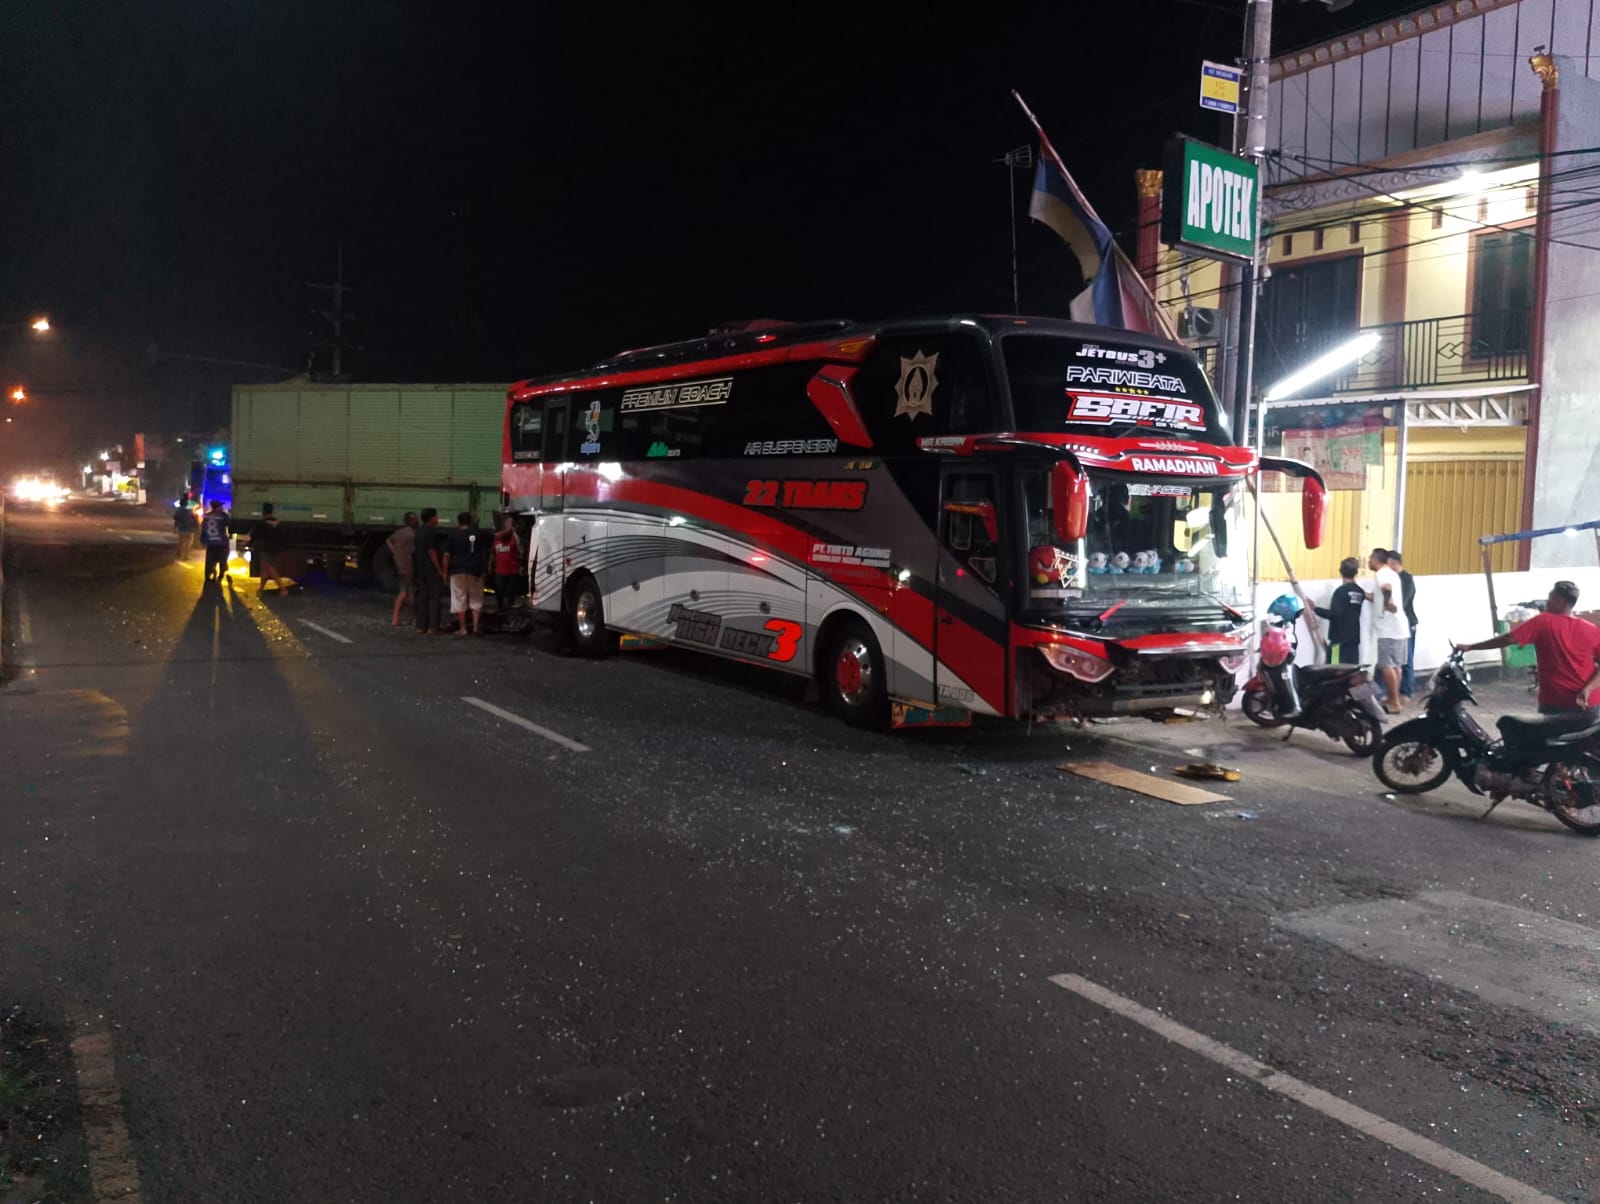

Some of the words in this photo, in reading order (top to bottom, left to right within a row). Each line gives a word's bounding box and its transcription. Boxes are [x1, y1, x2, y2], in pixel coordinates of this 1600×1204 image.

[1187, 160, 1254, 241] APOTEK
[1075, 348, 1139, 362] JETBUS
[1066, 366, 1187, 394] PARIWISATA
[620, 388, 678, 410] PREMIUM
[679, 382, 733, 404] COACH
[1072, 396, 1202, 423] SAFIR
[762, 438, 838, 455] SUSPENSION
[1131, 457, 1218, 475] RAMADHANI
[743, 480, 780, 507] 22
[781, 481, 868, 511] TRANS
[207, 519, 219, 536] 8
[675, 618, 721, 646] HIGH
[720, 626, 775, 658] DECK
[764, 617, 803, 663] 3
